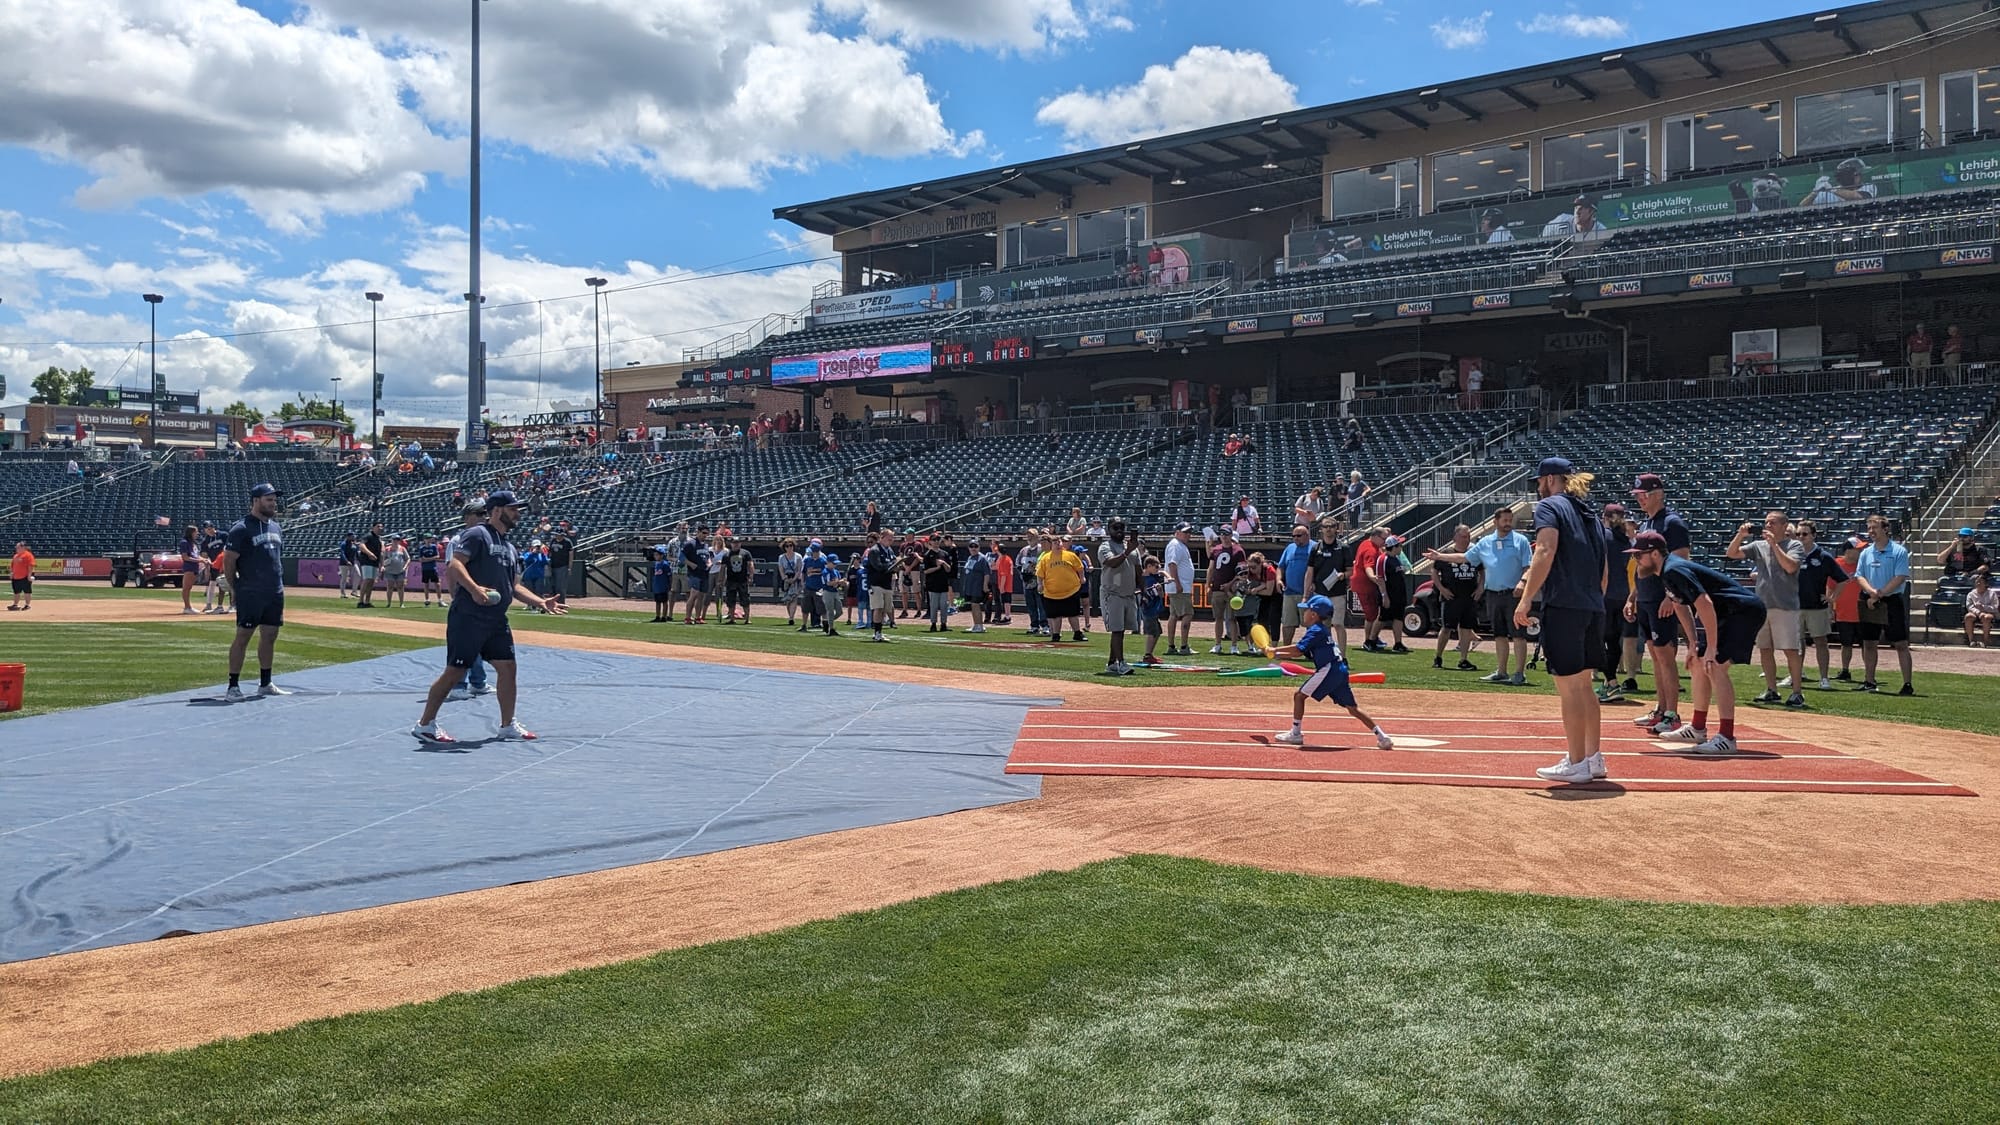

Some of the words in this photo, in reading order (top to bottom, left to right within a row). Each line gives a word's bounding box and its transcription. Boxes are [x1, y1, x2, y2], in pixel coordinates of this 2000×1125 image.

[1960, 158, 1998, 170] Lehigh
[1632, 199, 1663, 211] Lehigh
[1664, 196, 1693, 207] Valley
[1632, 207, 1686, 219] Orthopedic
[1688, 201, 1729, 213] Institute
[946, 214, 969, 232] PARTY
[970, 210, 997, 227] PORCH
[1383, 231, 1410, 242] Lehigh
[1409, 229, 1434, 239] Valley
[1956, 248, 1991, 260] NEWS
[1850, 259, 1882, 270] NEWS
[1045, 275, 1068, 285] Valley
[1702, 273, 1731, 284] NEWS
[1613, 281, 1640, 292] NEWS
[859, 295, 892, 307] SPEED
[1484, 294, 1509, 305] NEWS
[1408, 302, 1431, 312] NEWS
[932, 356, 938, 366] R
[947, 354, 953, 364] H
[963, 353, 967, 363] E
[986, 351, 991, 360] R
[1002, 348, 1007, 359] H
[1018, 347, 1023, 358] E
[692, 373, 704, 382] BALL
[710, 372, 727, 382] STRIKE
[733, 370, 744, 379] OUT
[78, 414, 99, 423] the
[101, 414, 132, 425] blast
[188, 420, 210, 430] grill
[66, 559, 81, 567] NOW
[1216, 552, 1230, 569] P
[63, 567, 84, 575] HIRING
